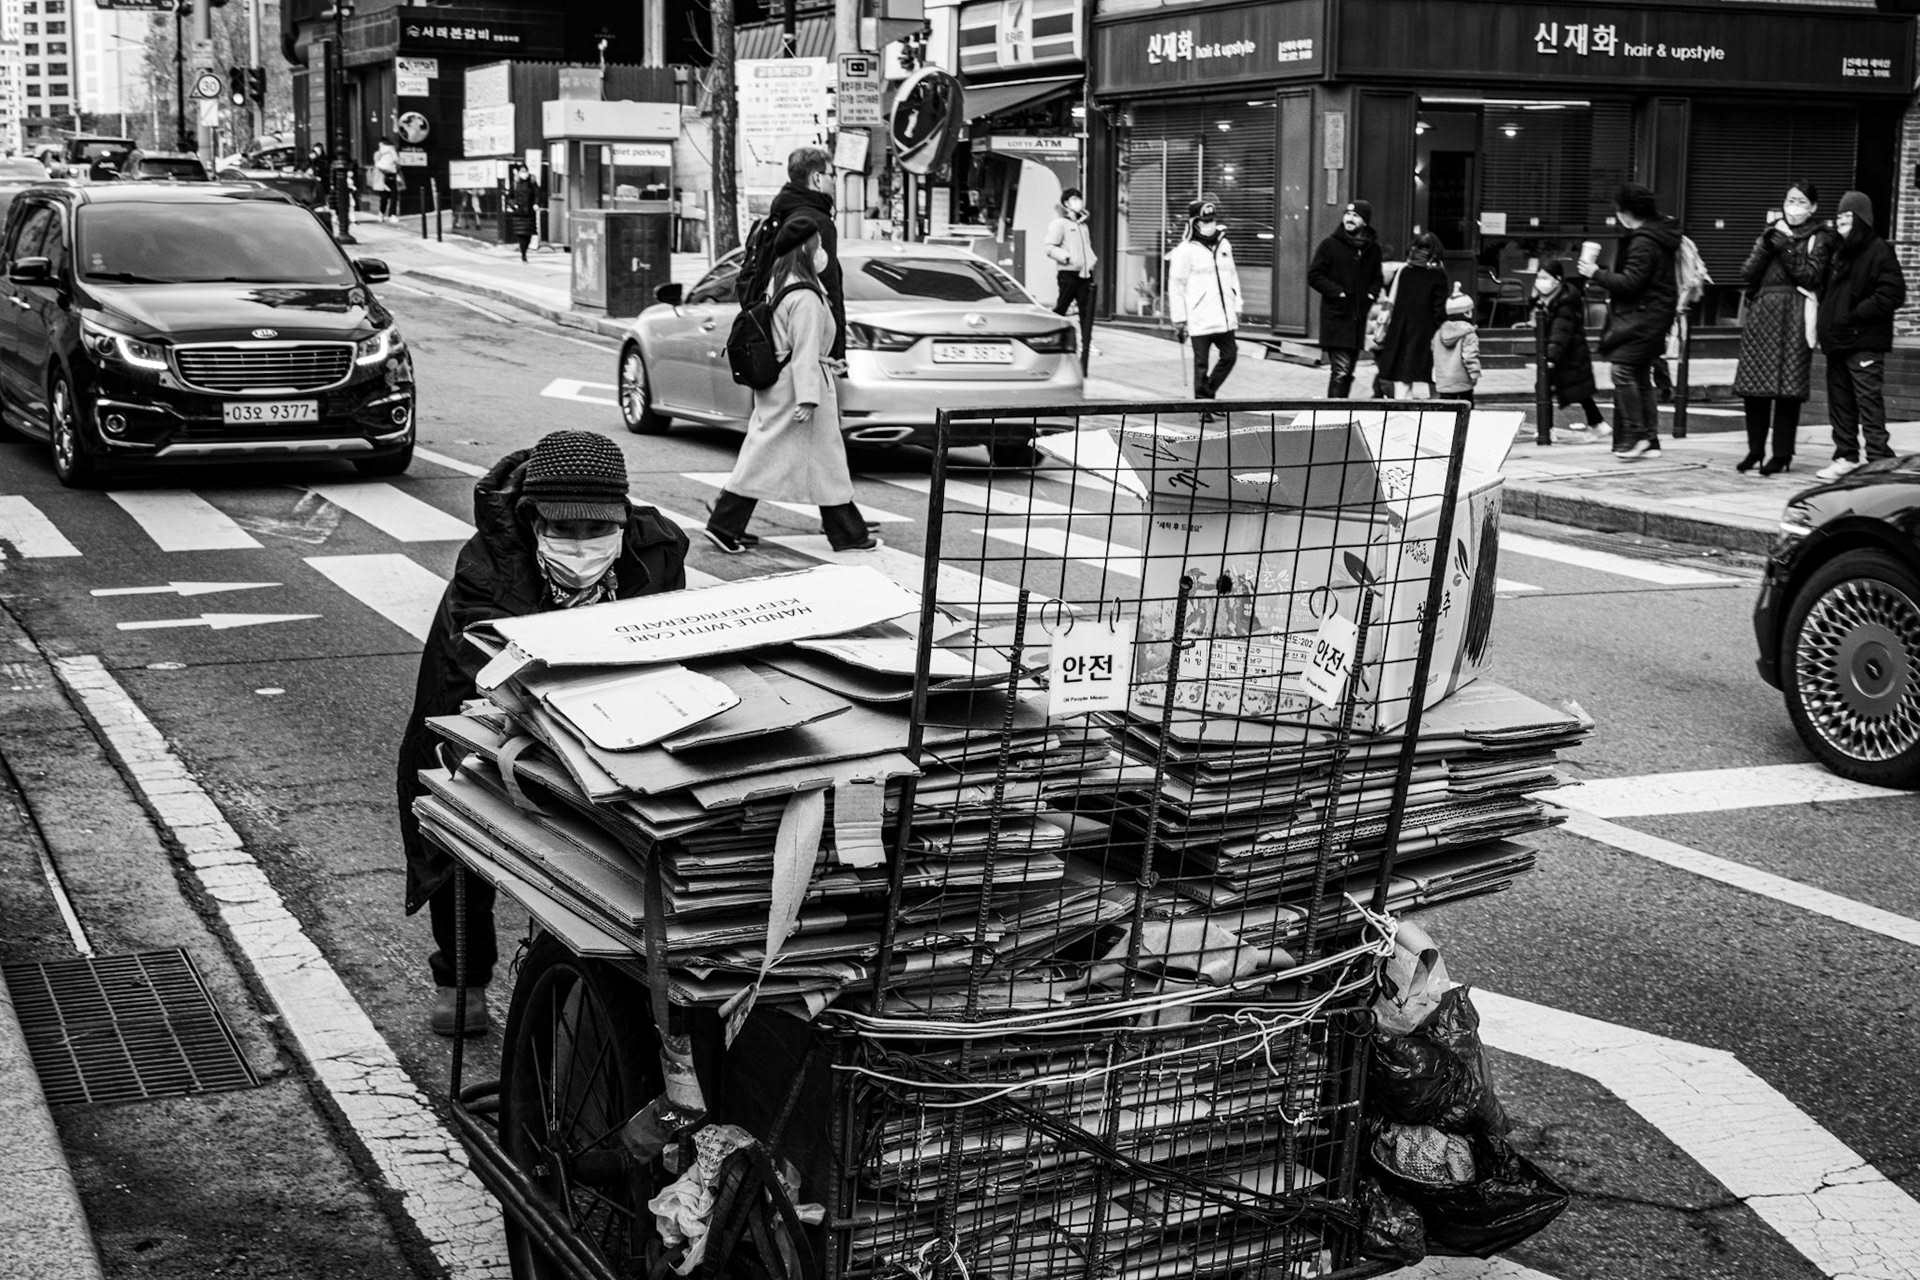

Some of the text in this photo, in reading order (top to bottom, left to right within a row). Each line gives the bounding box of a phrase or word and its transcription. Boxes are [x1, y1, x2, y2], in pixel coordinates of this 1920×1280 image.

[1147, 30, 1256, 64] 신재화 hair & upstyle
[1533, 22, 1725, 62] 신재화 hair & upstyle
[201, 81, 216, 92] 30
[232, 404, 309, 420] 03오 9377
[1181, 524, 1202, 532] 드요"
[614, 597, 801, 634] KEEP REFRIGERATED
[623, 605, 813, 644] HANDLE WITH CARE
[1062, 654, 1113, 683] 안전
[1313, 639, 1345, 677] 안전
